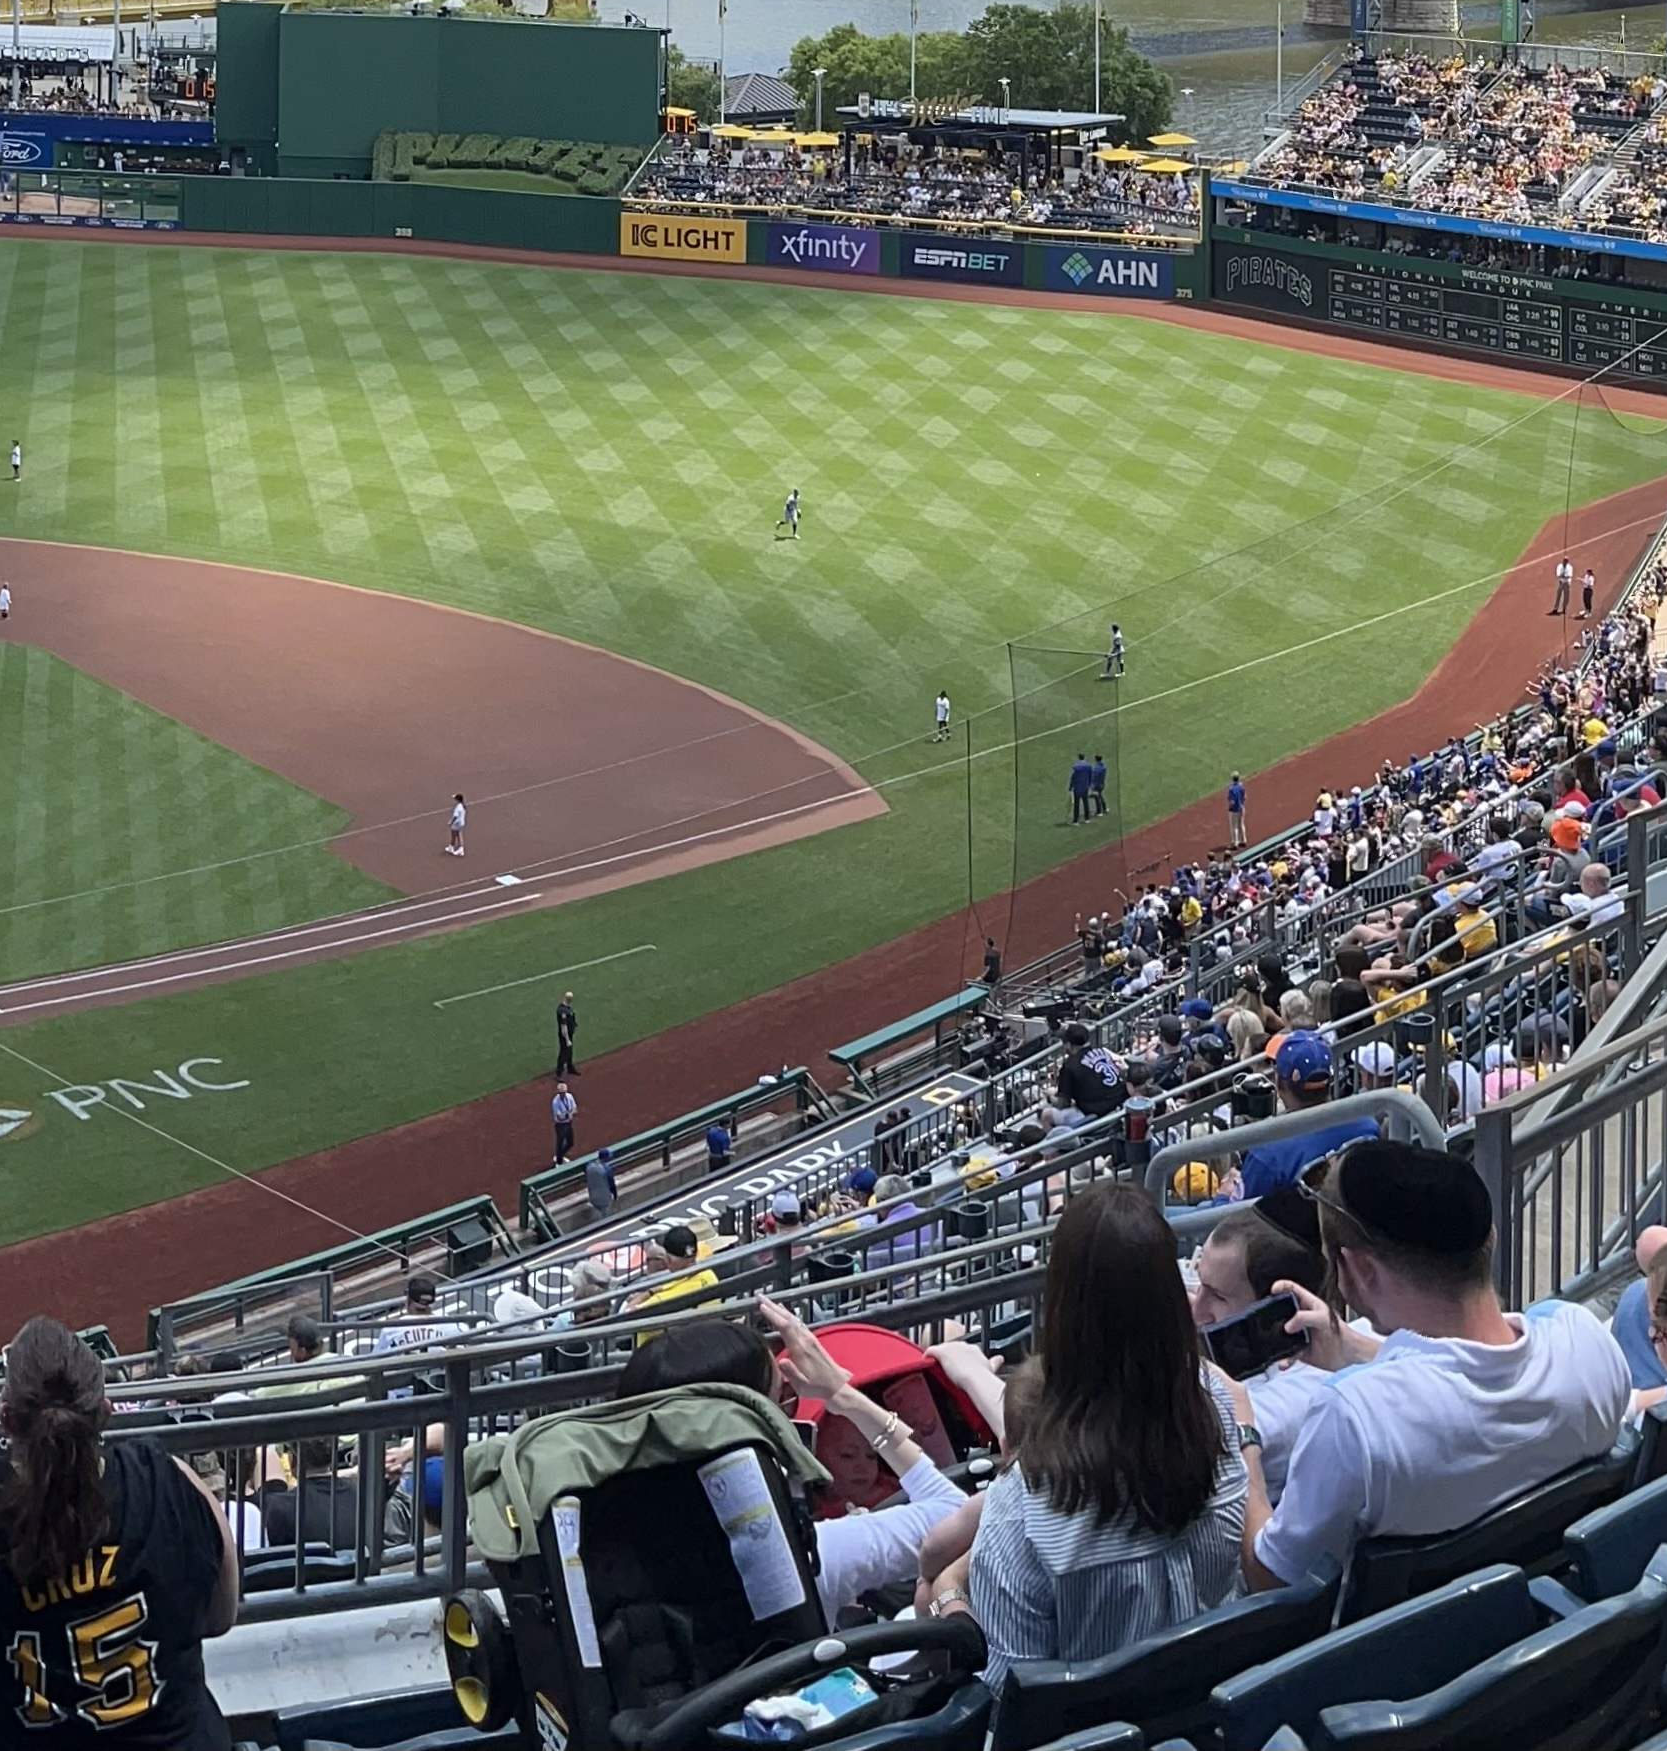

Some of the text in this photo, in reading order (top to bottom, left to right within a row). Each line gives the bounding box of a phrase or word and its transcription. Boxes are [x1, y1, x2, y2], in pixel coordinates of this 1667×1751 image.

[14, 46, 90, 63] HEAD'S
[631, 223, 735, 251] IC LIGHT
[781, 230, 867, 268] xfinity
[1097, 259, 1158, 287] AHN
[1227, 256, 1312, 306] PIRATES
[1461, 270, 1554, 291] WELCOME TO PNC PARK
[43, 1057, 251, 1121] PNC
[20, 1545, 121, 1612] CRUZ
[6, 1591, 167, 1732] 15
